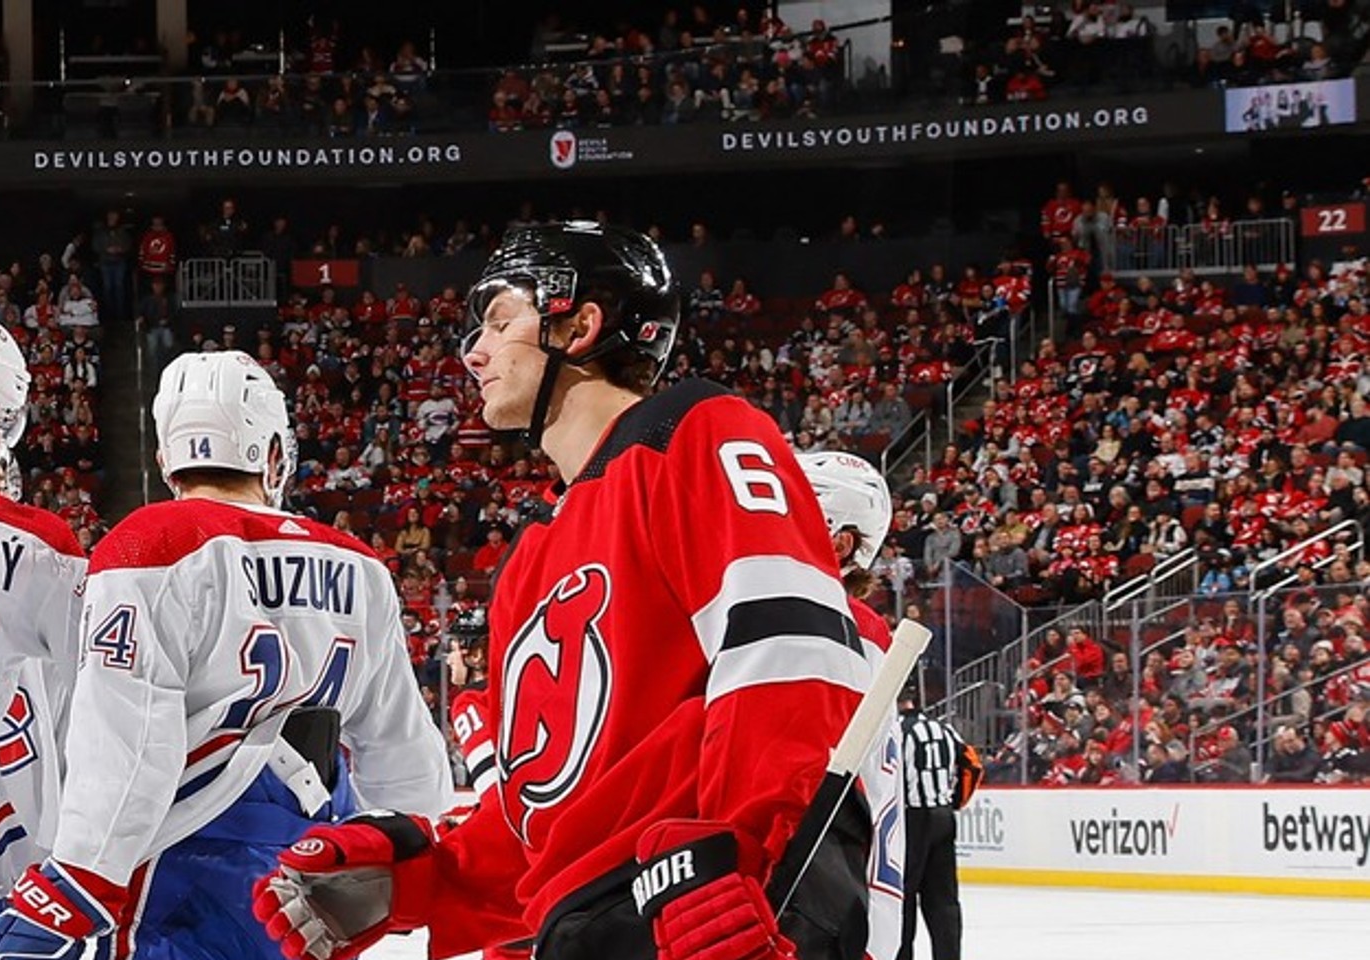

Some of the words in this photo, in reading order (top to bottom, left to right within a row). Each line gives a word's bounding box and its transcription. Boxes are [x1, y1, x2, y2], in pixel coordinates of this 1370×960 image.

[722, 106, 1149, 151] DEVILSYOUTHFOUNDATION.ORG
[34, 145, 462, 169] DEVILSYOUTHFOUNDATION.ORG
[1317, 208, 1348, 232] 22
[318, 263, 332, 284] 1
[189, 436, 212, 460] 14
[718, 440, 790, 517] 6
[240, 552, 357, 616] SUZUKI
[1070, 808, 1169, 856] verizon
[1262, 801, 1370, 866] betway
